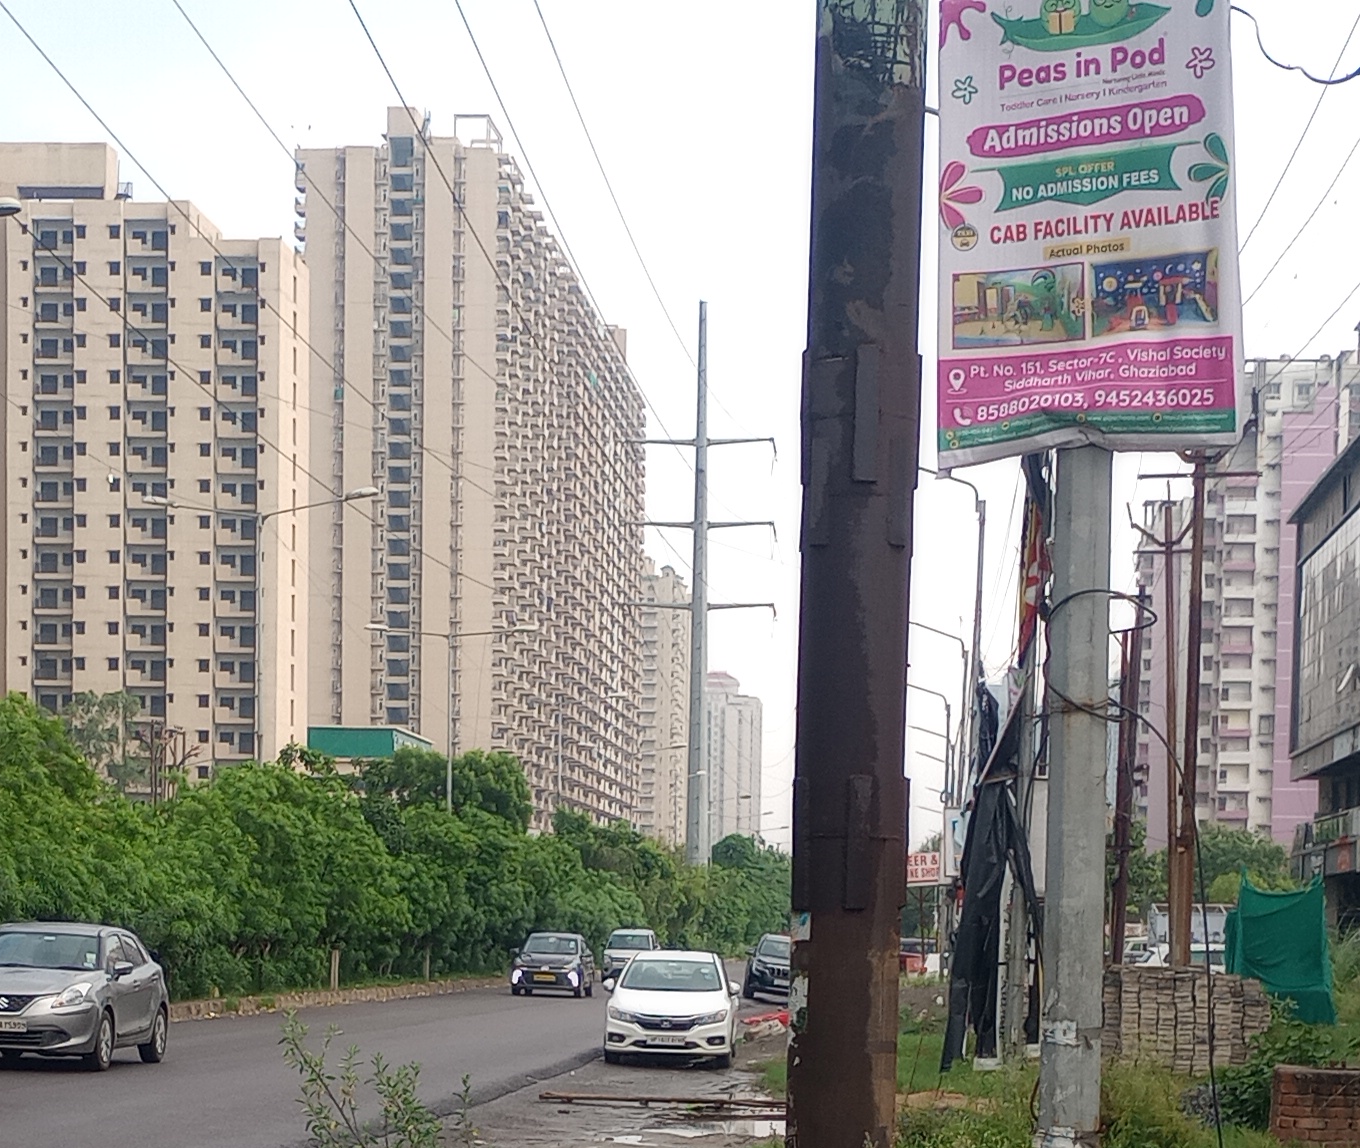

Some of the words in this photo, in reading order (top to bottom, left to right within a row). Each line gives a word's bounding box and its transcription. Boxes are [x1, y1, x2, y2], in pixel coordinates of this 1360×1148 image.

[999, 64, 1066, 91] Peas
[1076, 52, 1101, 78] in
[1111, 37, 1164, 73] Pod
[1000, 101, 1034, 112] Toddler
[1037, 97, 1058, 107] Care
[1065, 90, 1101, 104] Nursery
[1108, 80, 1168, 97] Kindergarten
[983, 115, 1122, 153] Admissions
[1127, 105, 1189, 135] Open
[1012, 186, 1034, 201] NO
[1037, 174, 1119, 199] ADMISSION
[1122, 169, 1160, 187] FEES
[1055, 165, 1076, 177] SPL
[1078, 161, 1115, 174] OFFER
[990, 223, 1028, 244] CAB
[1034, 212, 1115, 240] FACILITY
[1120, 200, 1220, 231] AVAILABLE
[1049, 246, 1083, 259] Actual
[1086, 241, 1125, 254] Photos
[993, 363, 1017, 377] No.
[1127, 347, 1170, 362] Vishal
[1173, 345, 1226, 360] Society
[1004, 373, 1072, 392] Siddharth
[1119, 362, 1196, 378] Ghaziabad
[1094, 388, 1214, 408] 9452436025
[908, 855, 927, 867] EER
